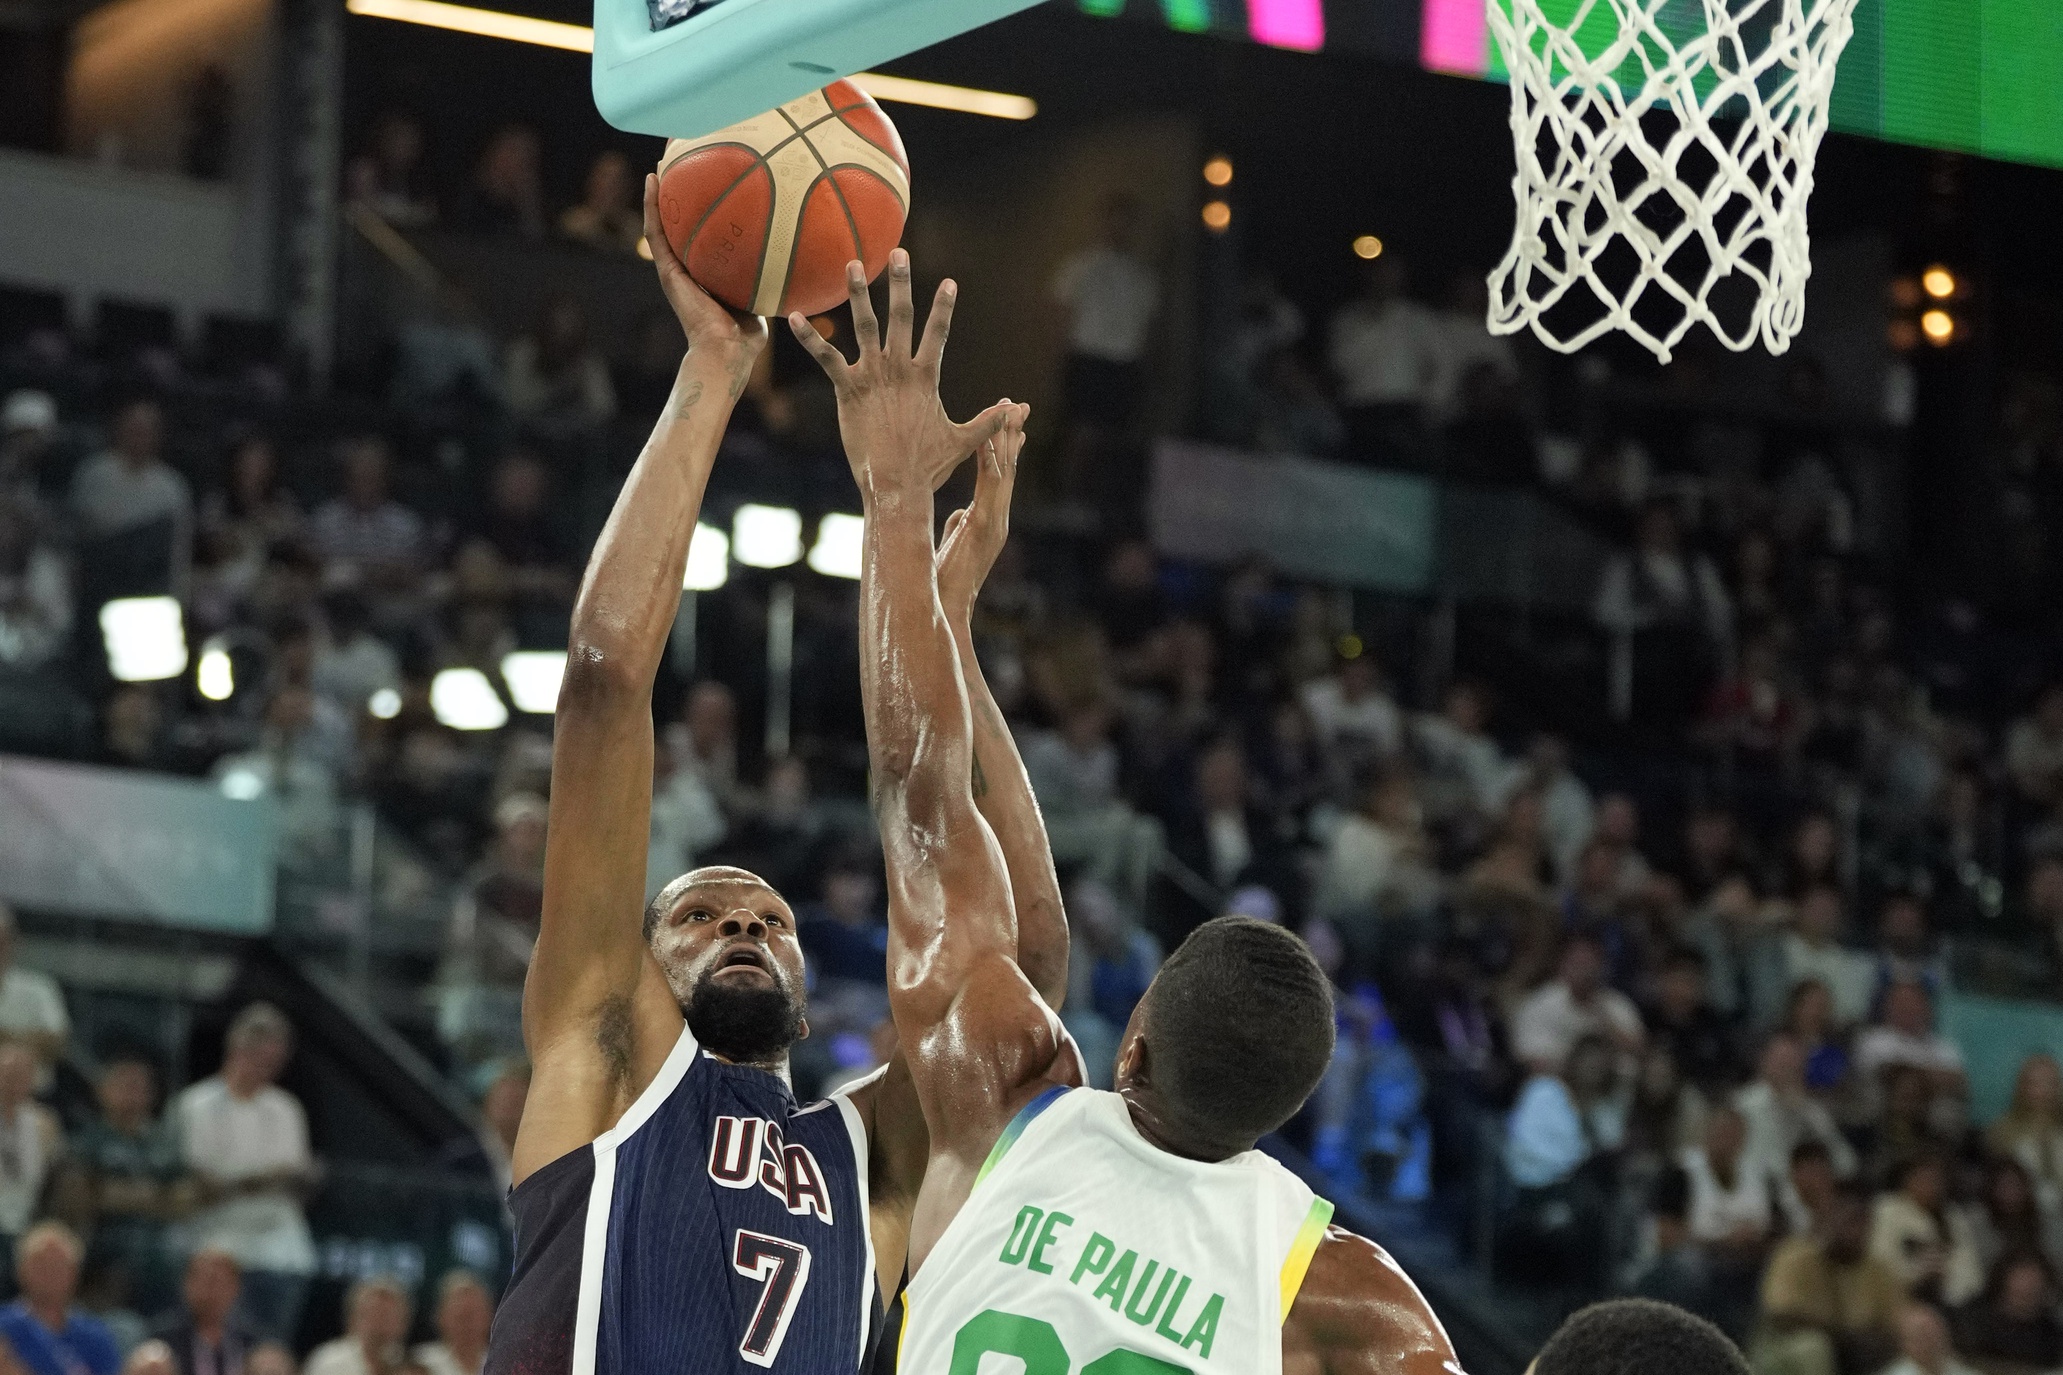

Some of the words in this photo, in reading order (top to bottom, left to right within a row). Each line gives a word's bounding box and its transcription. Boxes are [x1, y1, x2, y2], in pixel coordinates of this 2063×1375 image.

[708, 1116, 833, 1225] USA
[732, 1229, 812, 1368] 7
[998, 1205, 1075, 1275] DE
[1069, 1231, 1225, 1359] PAULA
